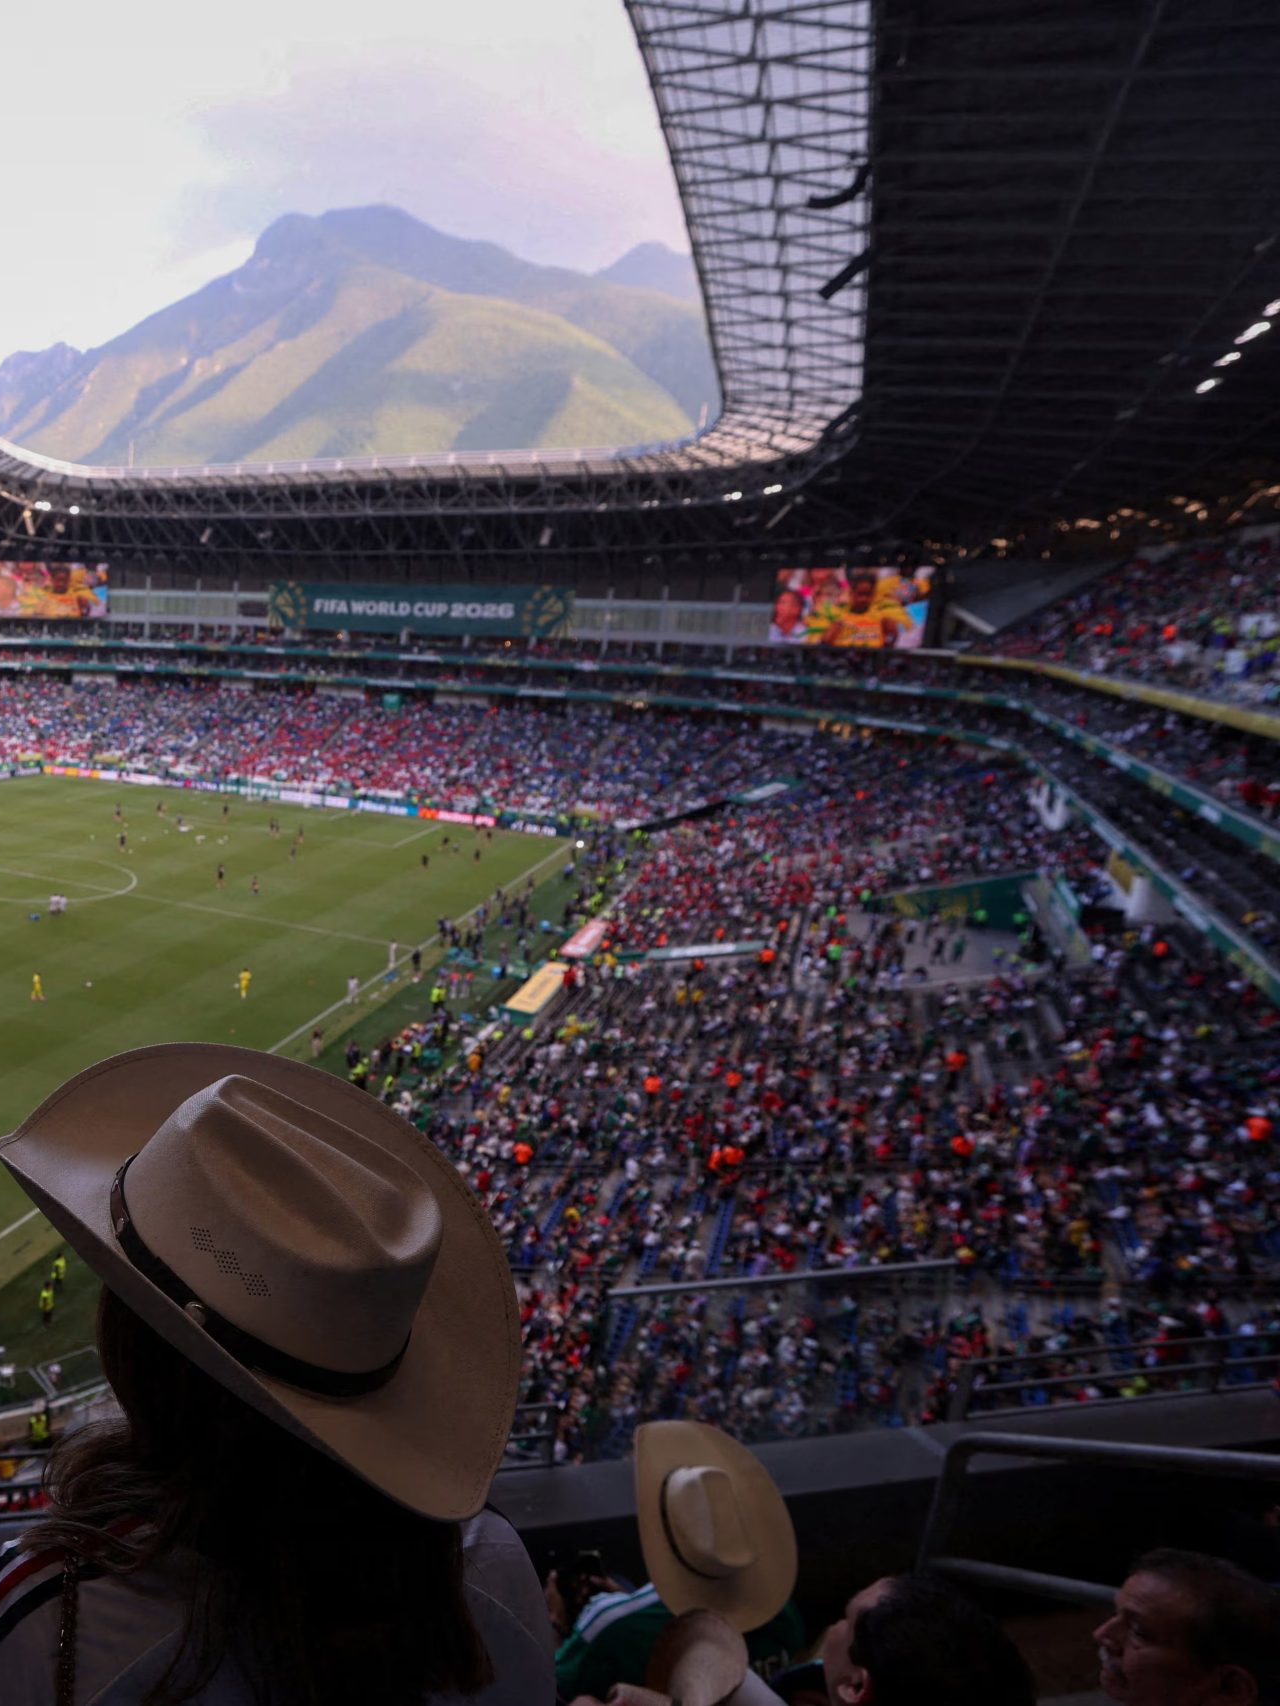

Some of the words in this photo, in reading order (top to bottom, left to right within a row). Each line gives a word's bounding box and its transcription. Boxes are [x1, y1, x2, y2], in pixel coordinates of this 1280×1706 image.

[314, 598, 348, 614] FIFA
[352, 600, 410, 616] WORLD
[413, 602, 448, 618] CUP
[450, 603, 515, 619] 2026
